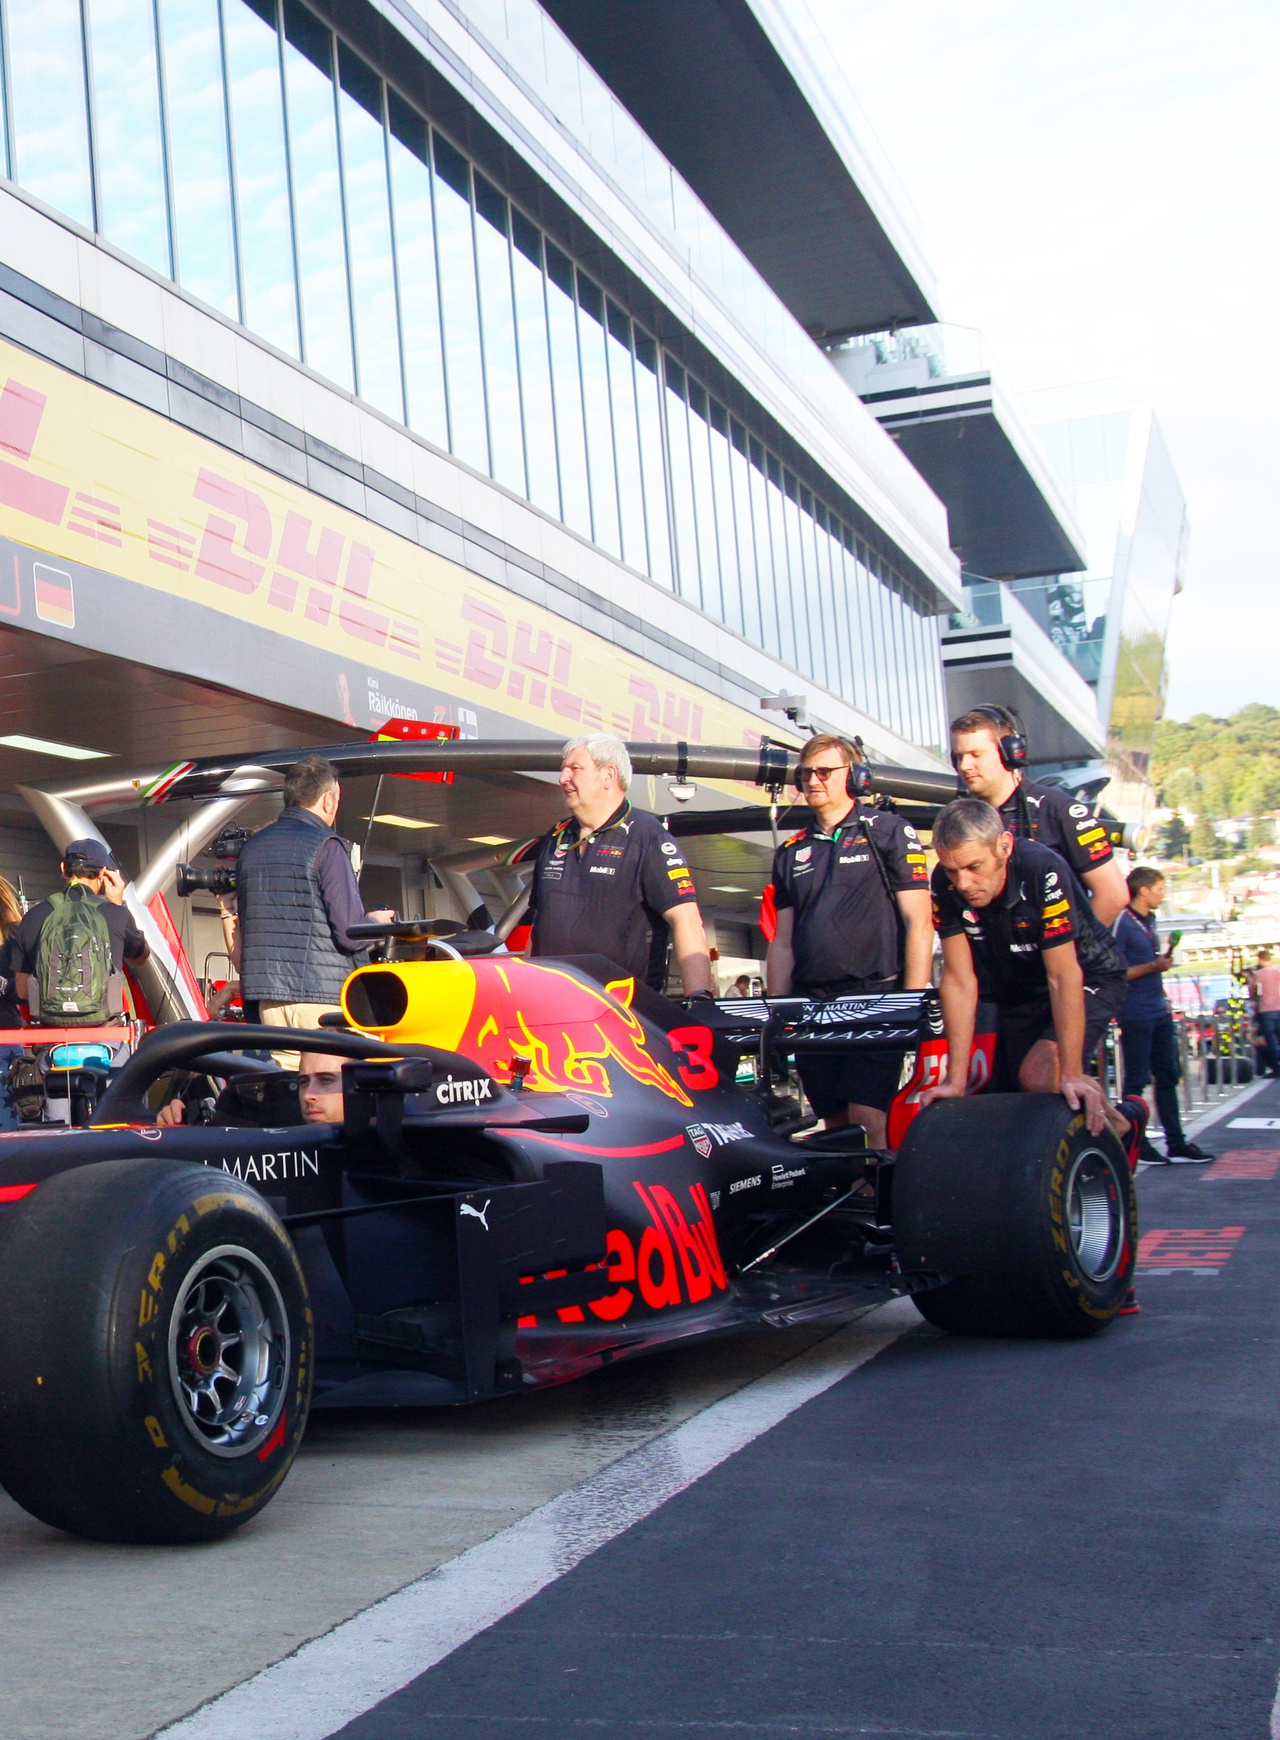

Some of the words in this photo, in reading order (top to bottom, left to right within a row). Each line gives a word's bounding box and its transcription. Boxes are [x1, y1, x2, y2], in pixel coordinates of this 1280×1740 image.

[192, 467, 390, 646] DHL
[463, 593, 589, 722] DHL
[367, 676, 379, 689] Kimi
[824, 1002, 867, 1011] MARTIN
[666, 1026, 719, 1090] 3
[689, 1127, 704, 1138] TAG
[222, 1151, 319, 1182] MARTIN
[729, 1175, 762, 1194] SIEMENS
